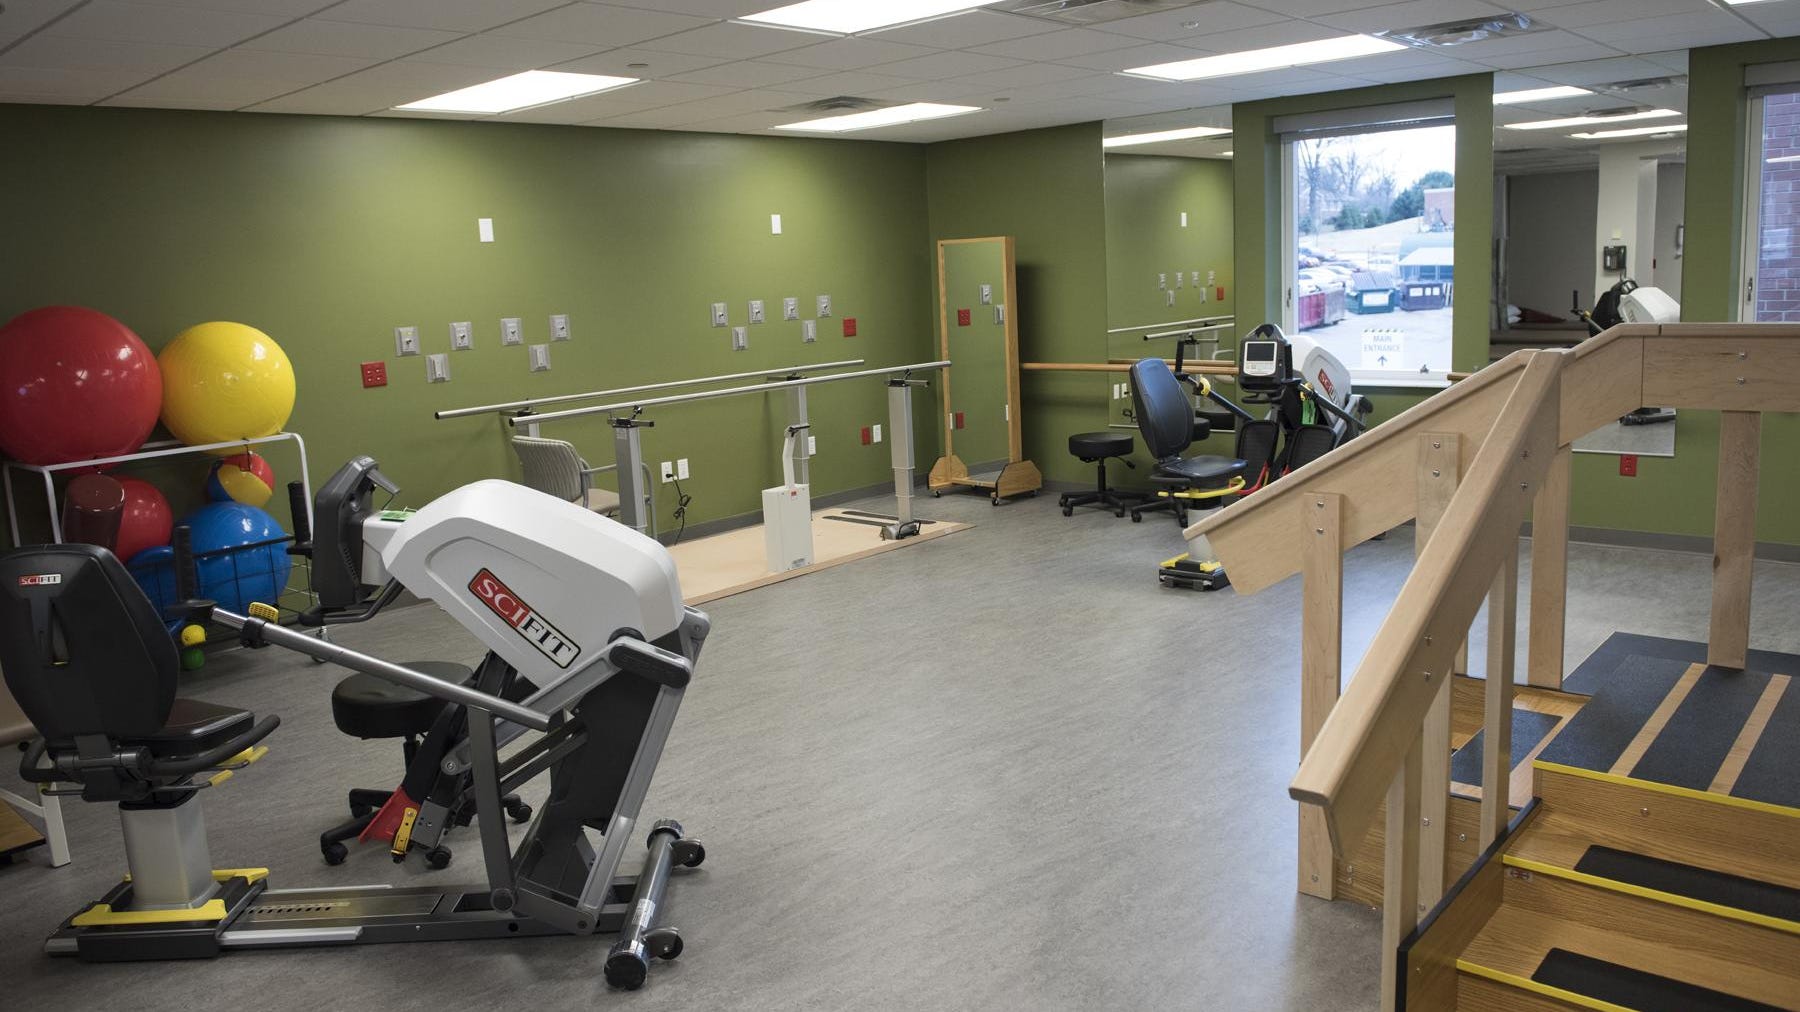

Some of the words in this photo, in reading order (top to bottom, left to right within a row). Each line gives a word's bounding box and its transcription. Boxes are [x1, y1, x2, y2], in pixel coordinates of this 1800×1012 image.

[1363, 344, 1401, 352] ENTRANCE
[20, 575, 60, 585] SCIFIT
[477, 578, 573, 658] SCIFIT
